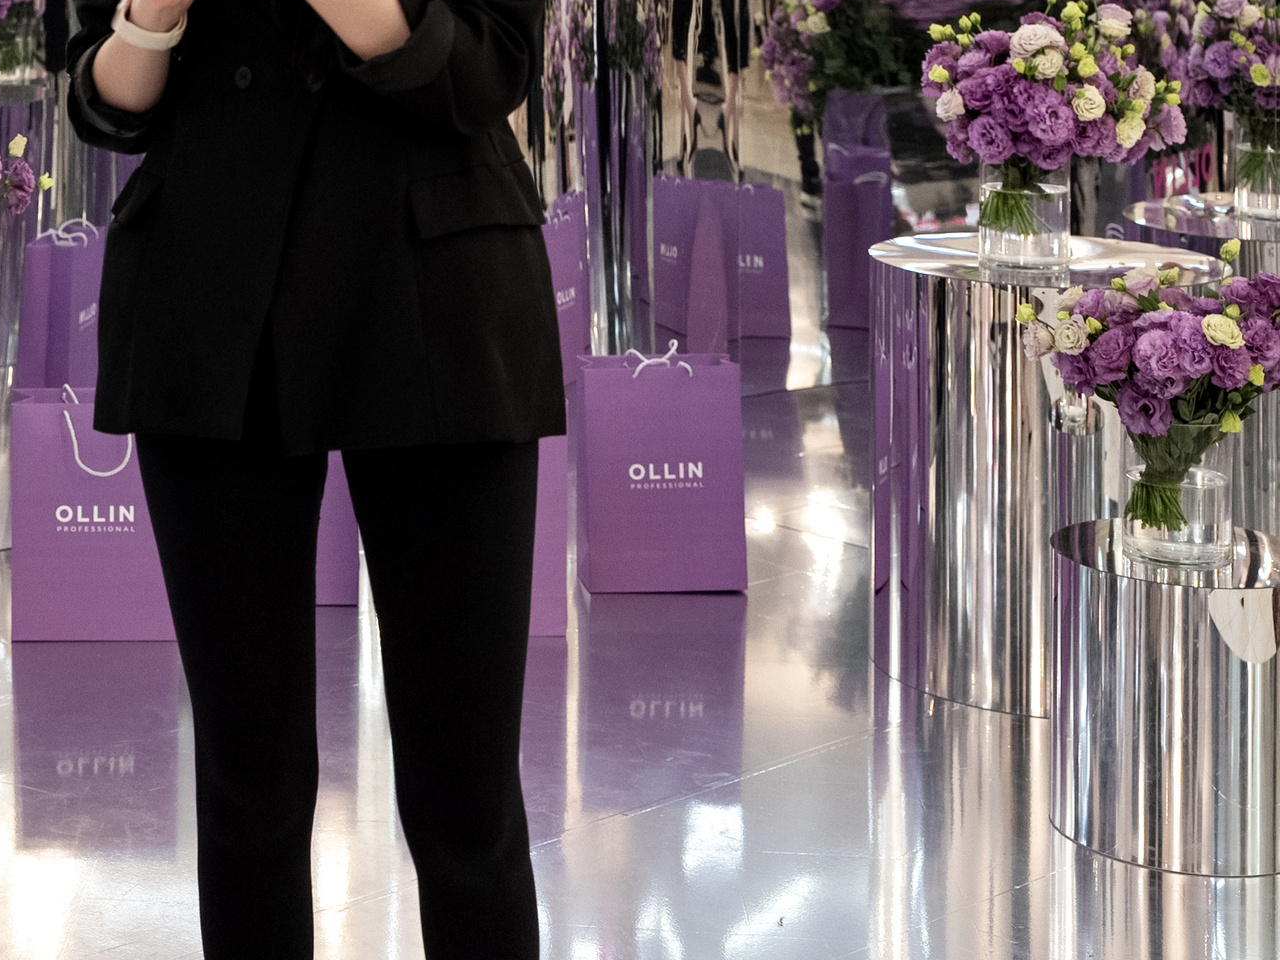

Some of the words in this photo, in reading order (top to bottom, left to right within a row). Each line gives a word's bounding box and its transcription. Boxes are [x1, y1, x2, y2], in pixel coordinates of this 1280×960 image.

[629, 462, 703, 481] OLLIN
[630, 482, 704, 490] PROFESSIONAL
[55, 505, 135, 523] OLLIN
